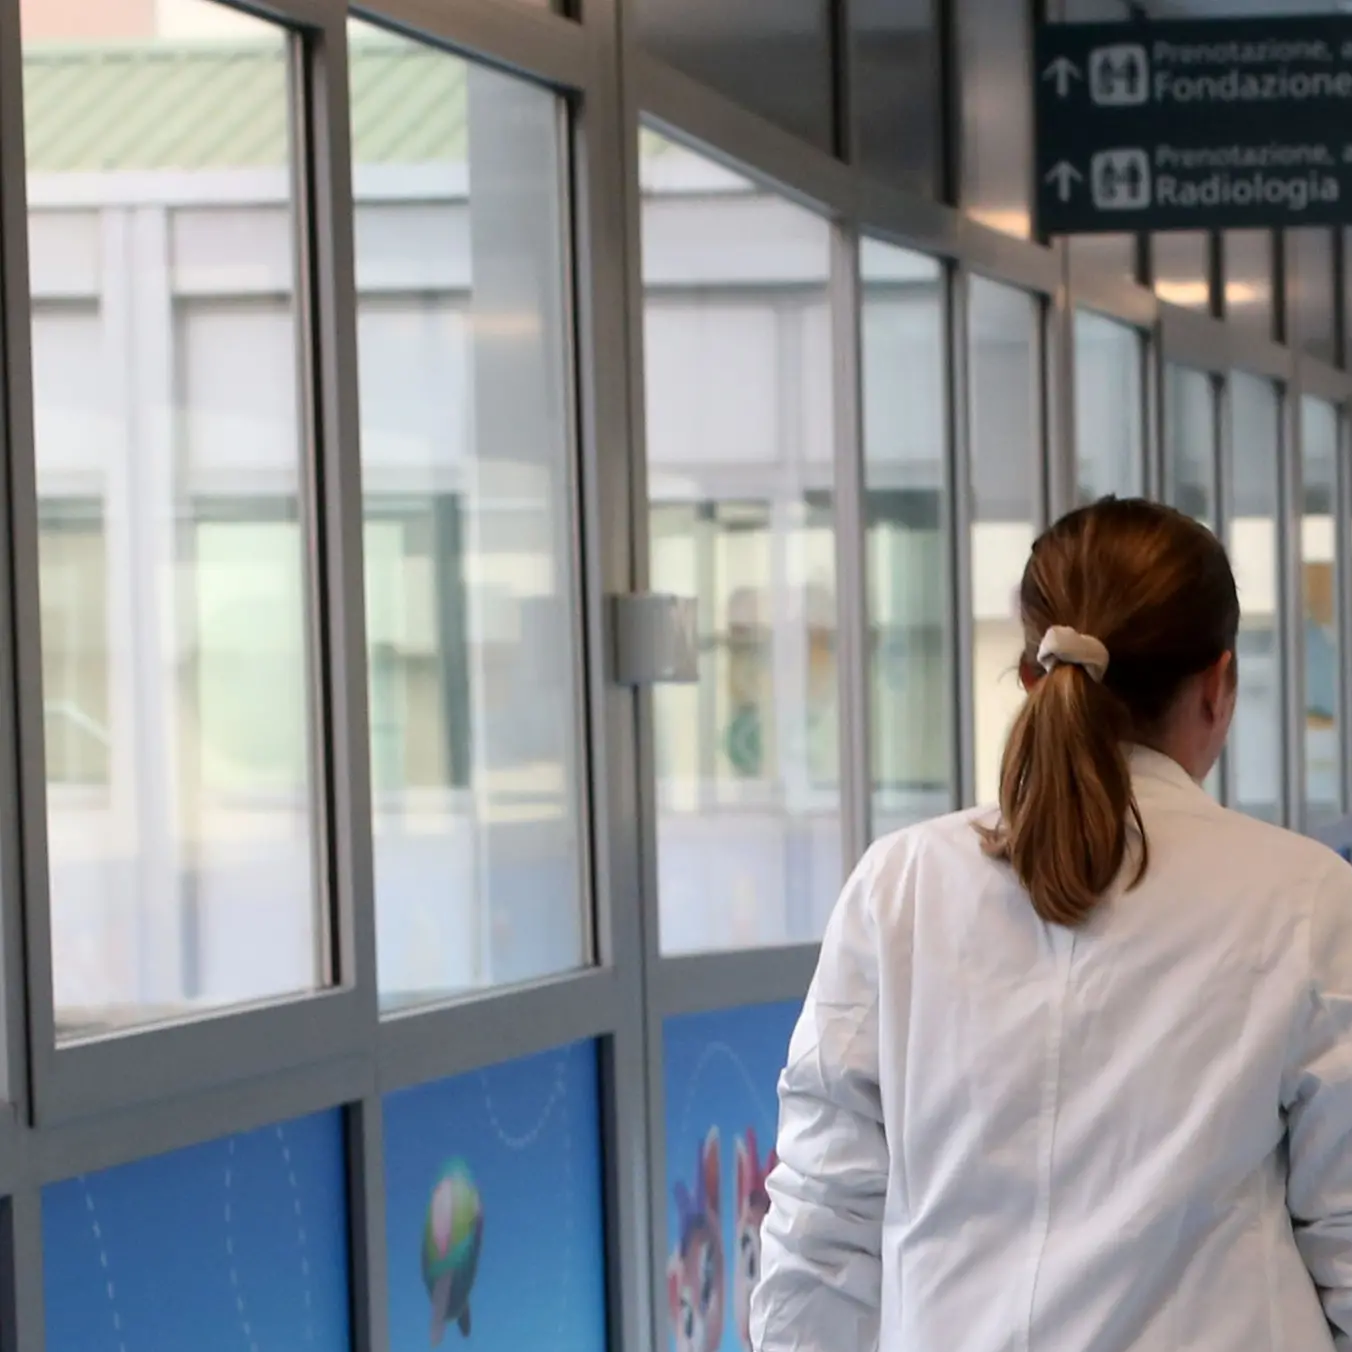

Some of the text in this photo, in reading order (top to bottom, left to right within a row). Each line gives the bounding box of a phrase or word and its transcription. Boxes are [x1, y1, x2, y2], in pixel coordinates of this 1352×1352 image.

[1152, 40, 1333, 64] Prenotazione,
[1155, 143, 1336, 167] Prenotazione,
[1156, 171, 1340, 210] Radiologia
